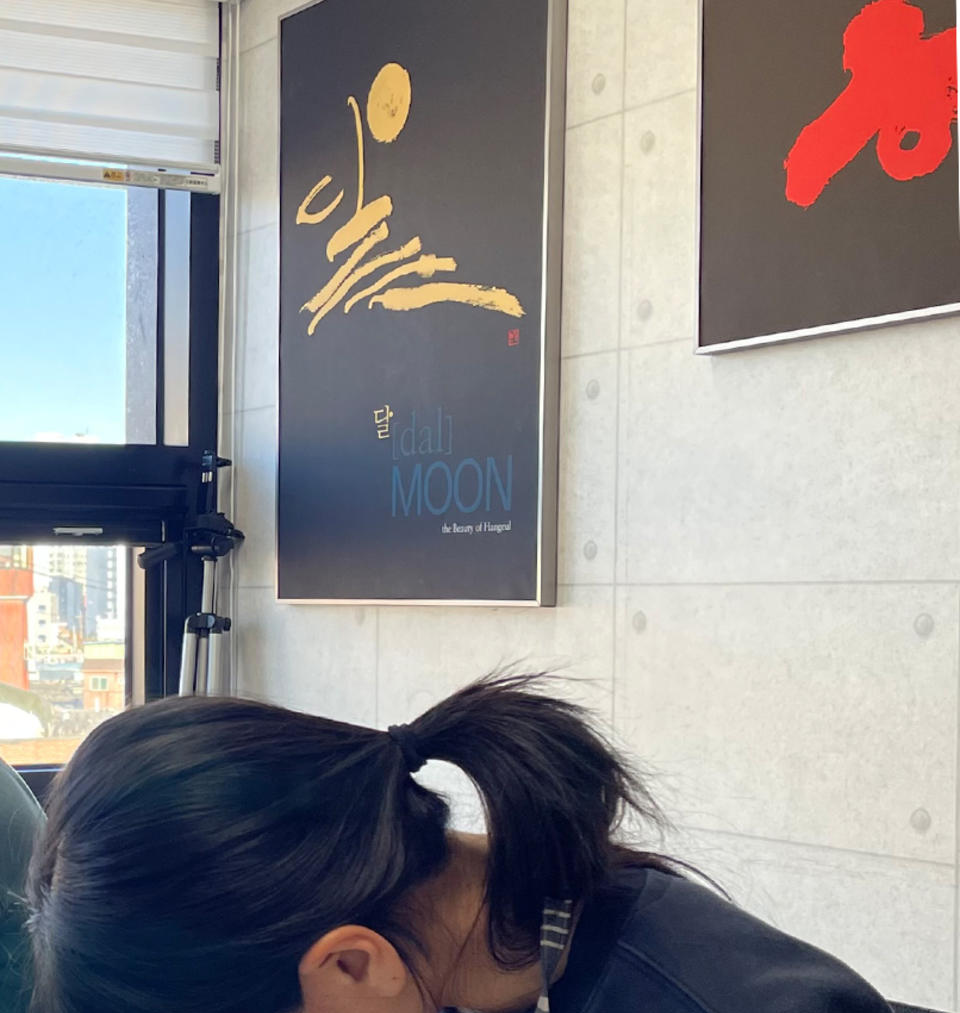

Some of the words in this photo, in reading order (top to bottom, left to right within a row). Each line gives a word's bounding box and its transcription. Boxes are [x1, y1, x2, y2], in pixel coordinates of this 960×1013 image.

[373, 404, 394, 440] 달
[391, 455, 513, 517] MOON
[441, 523, 452, 534] the
[452, 522, 474, 535] Beauty
[475, 521, 483, 532] of
